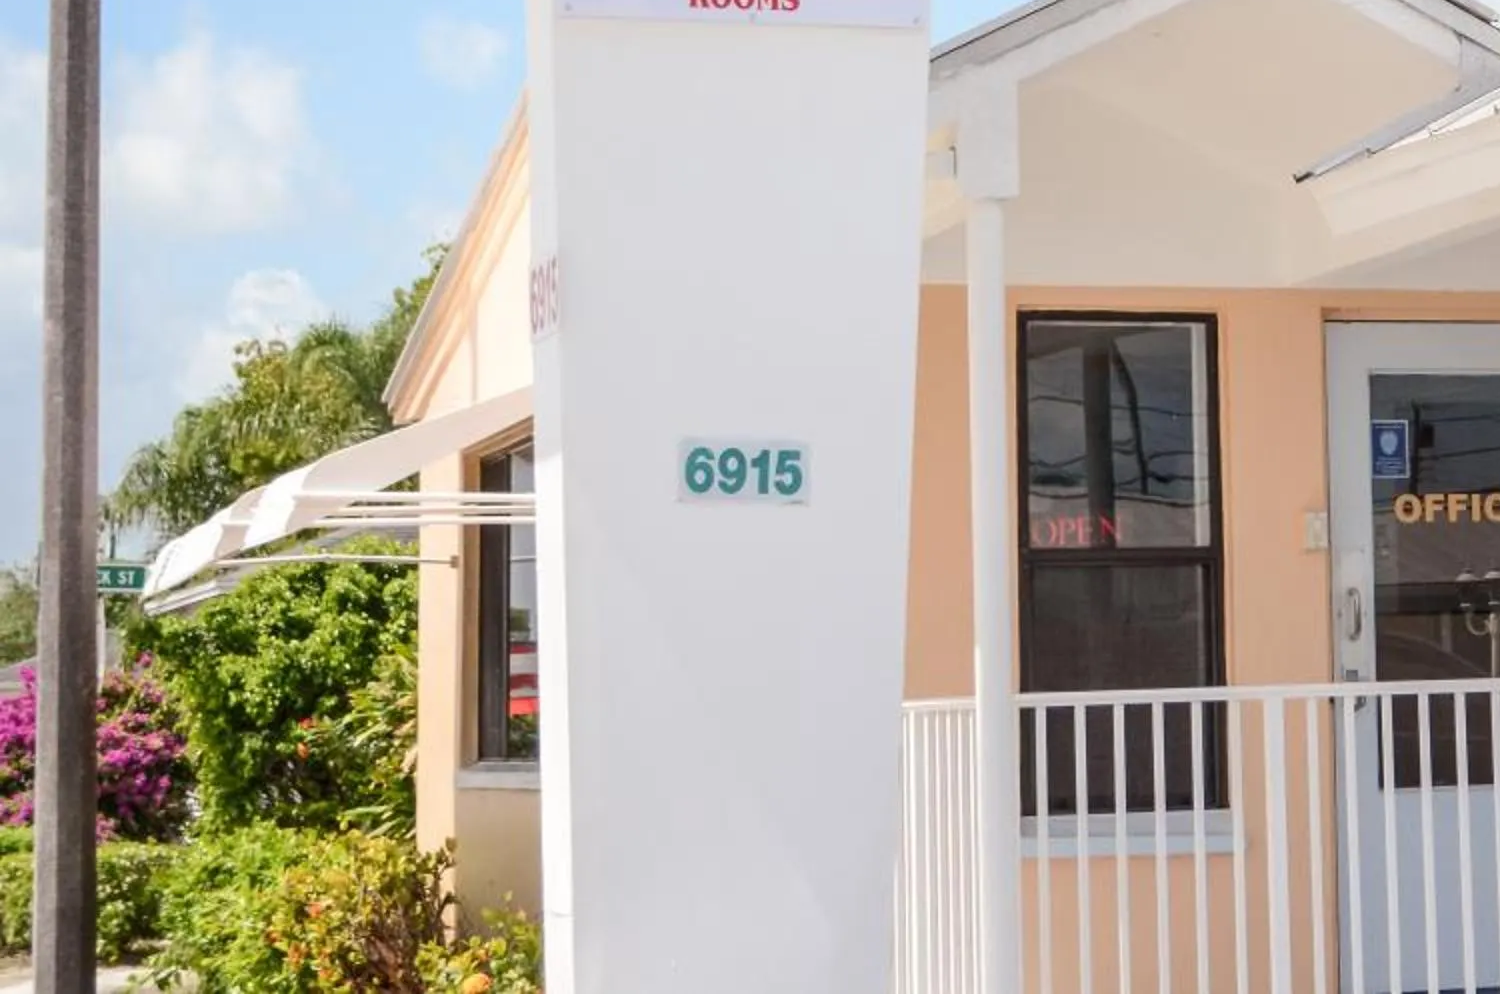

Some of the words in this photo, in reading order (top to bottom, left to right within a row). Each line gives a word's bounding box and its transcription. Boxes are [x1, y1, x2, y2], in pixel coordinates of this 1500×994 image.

[530, 254, 559, 335] 6915
[684, 446, 804, 496] 6915
[1031, 509, 1123, 547] OPEN
[116, 570, 136, 586] ST
